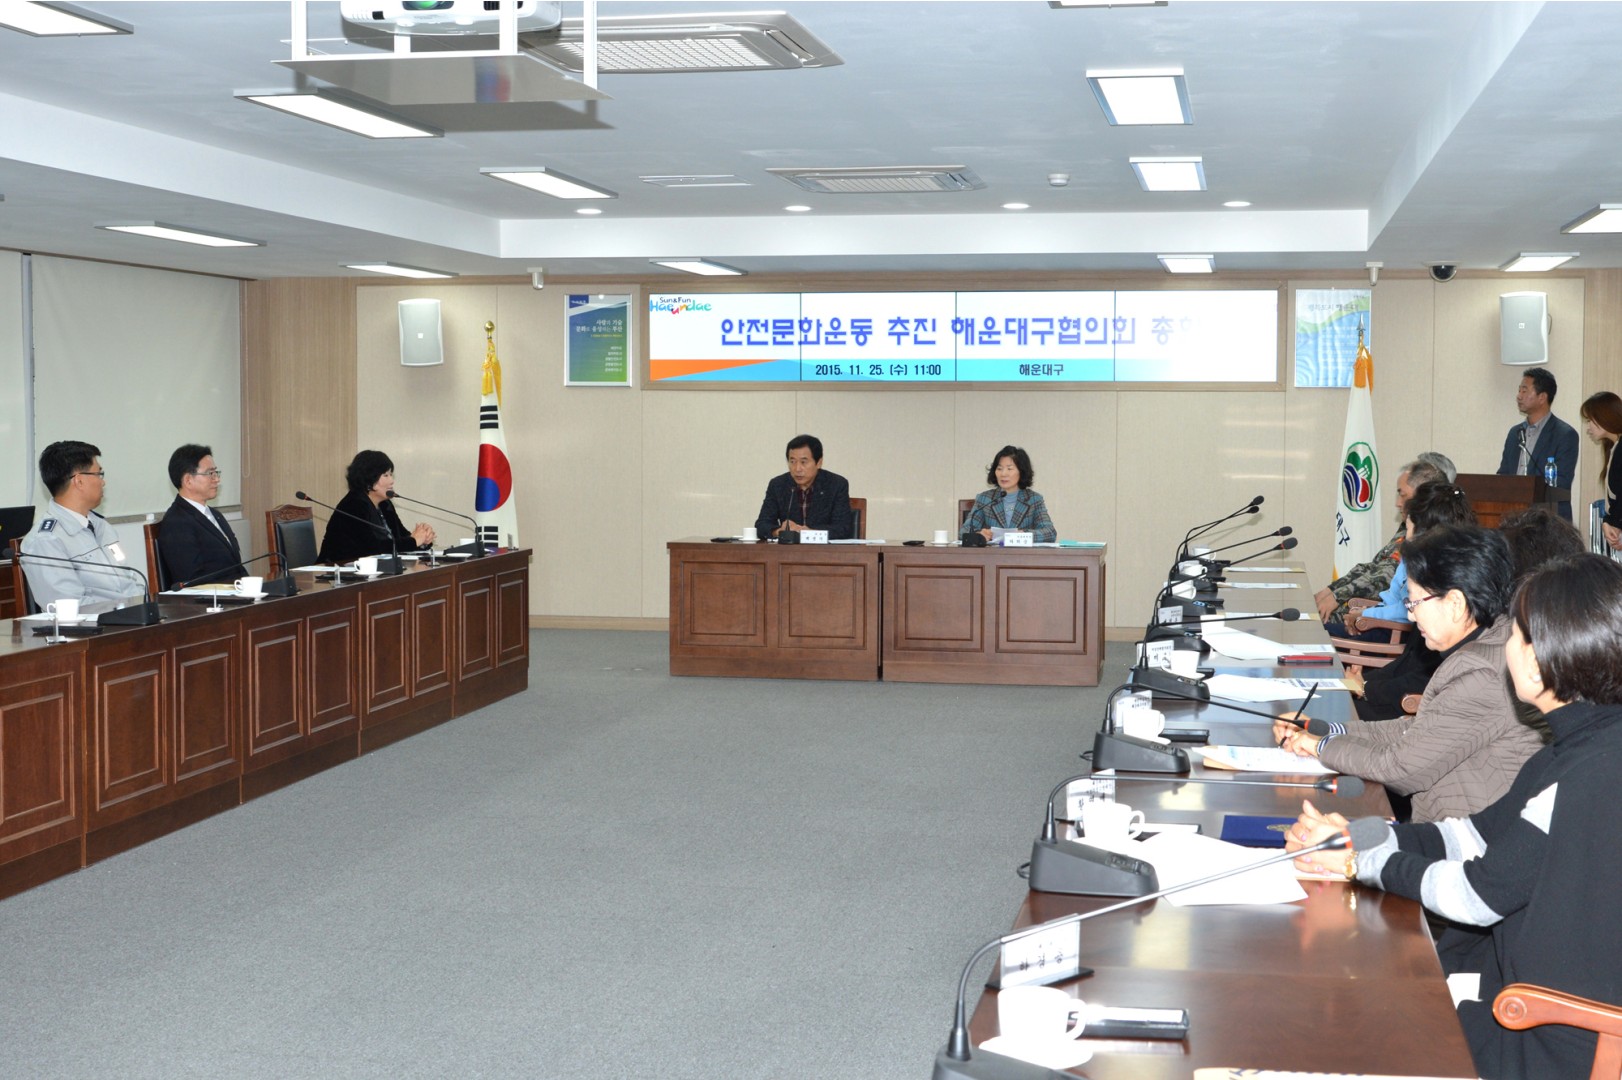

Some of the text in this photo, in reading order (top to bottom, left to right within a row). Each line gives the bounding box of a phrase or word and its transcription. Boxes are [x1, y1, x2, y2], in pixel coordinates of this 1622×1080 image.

[649, 299, 712, 315] Haeundae
[659, 296, 692, 304] Sun&Fun
[720, 316, 874, 347] 안전문화운동
[887, 316, 937, 346] 추진
[950, 315, 1137, 347] 해운대구협의회
[815, 364, 942, 376] 2015. 11. 25. (수) 11:00
[1018, 363, 1065, 377] 해운대구
